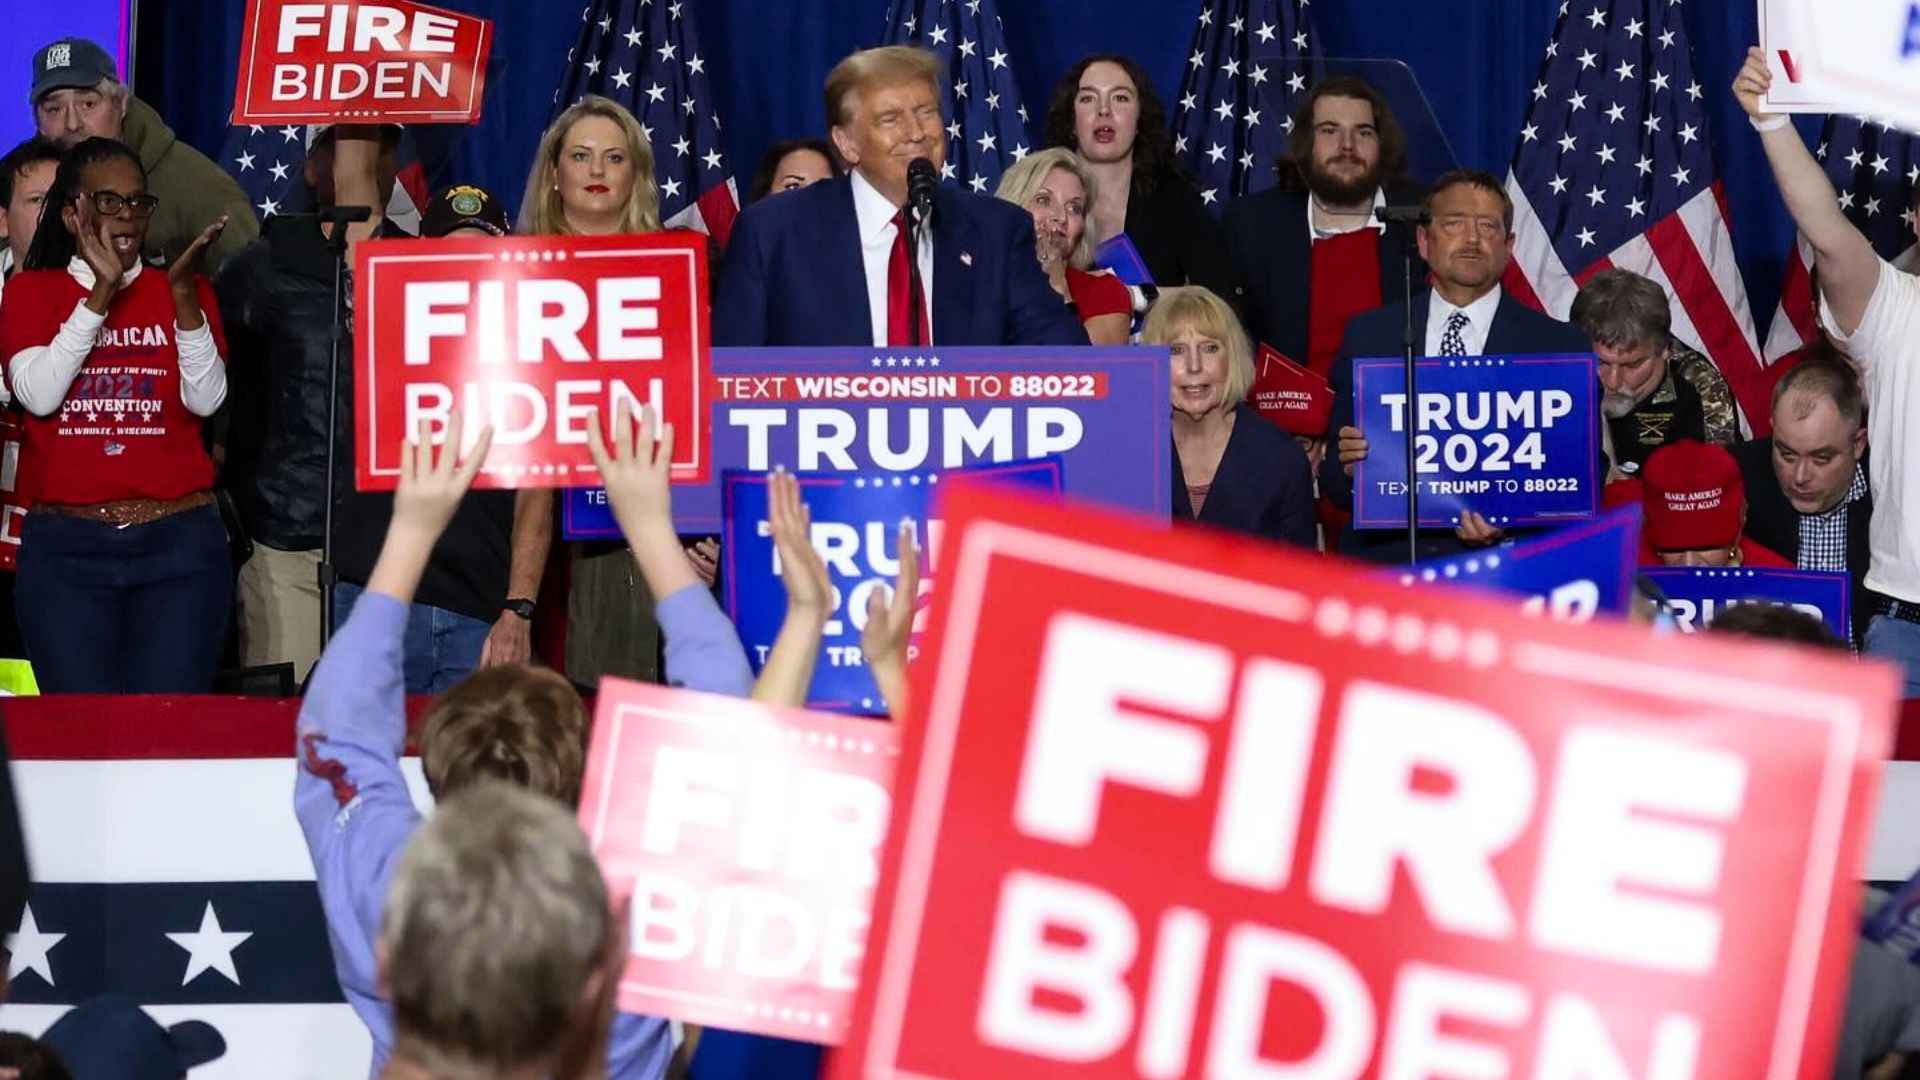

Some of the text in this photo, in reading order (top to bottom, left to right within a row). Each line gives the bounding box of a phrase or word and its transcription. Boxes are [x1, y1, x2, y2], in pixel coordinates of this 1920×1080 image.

[277, 4, 459, 53] FIRE
[271, 62, 452, 101] BIDEN
[404, 276, 663, 365] FIRE
[91, 367, 109, 375] LIFE
[110, 367, 121, 375] OF
[124, 366, 141, 375] THE
[79, 374, 153, 399] 2024
[718, 374, 1095, 399] TEXT WISCONSIN TO 88022
[1277, 391, 1312, 401] AMERICA
[63, 399, 163, 412] CONVENTION
[405, 378, 663, 446] BIDEN
[1259, 401, 1309, 410] GREAT AGAIN
[1380, 389, 1573, 431] TRUMP
[116, 427, 166, 435] WISCONSIN
[729, 406, 1084, 472] TRUMP
[1415, 432, 1546, 473] 2024
[1377, 478, 1578, 495] TEXT TRUMP TO 88022
[1664, 492, 1687, 501] MAKE
[1668, 497, 1721, 511] GREAT AGAIN
[827, 645, 920, 667] TRP
[1013, 611, 1748, 977] FIRE
[640, 745, 891, 887] FIR
[630, 871, 872, 991] BIDE
